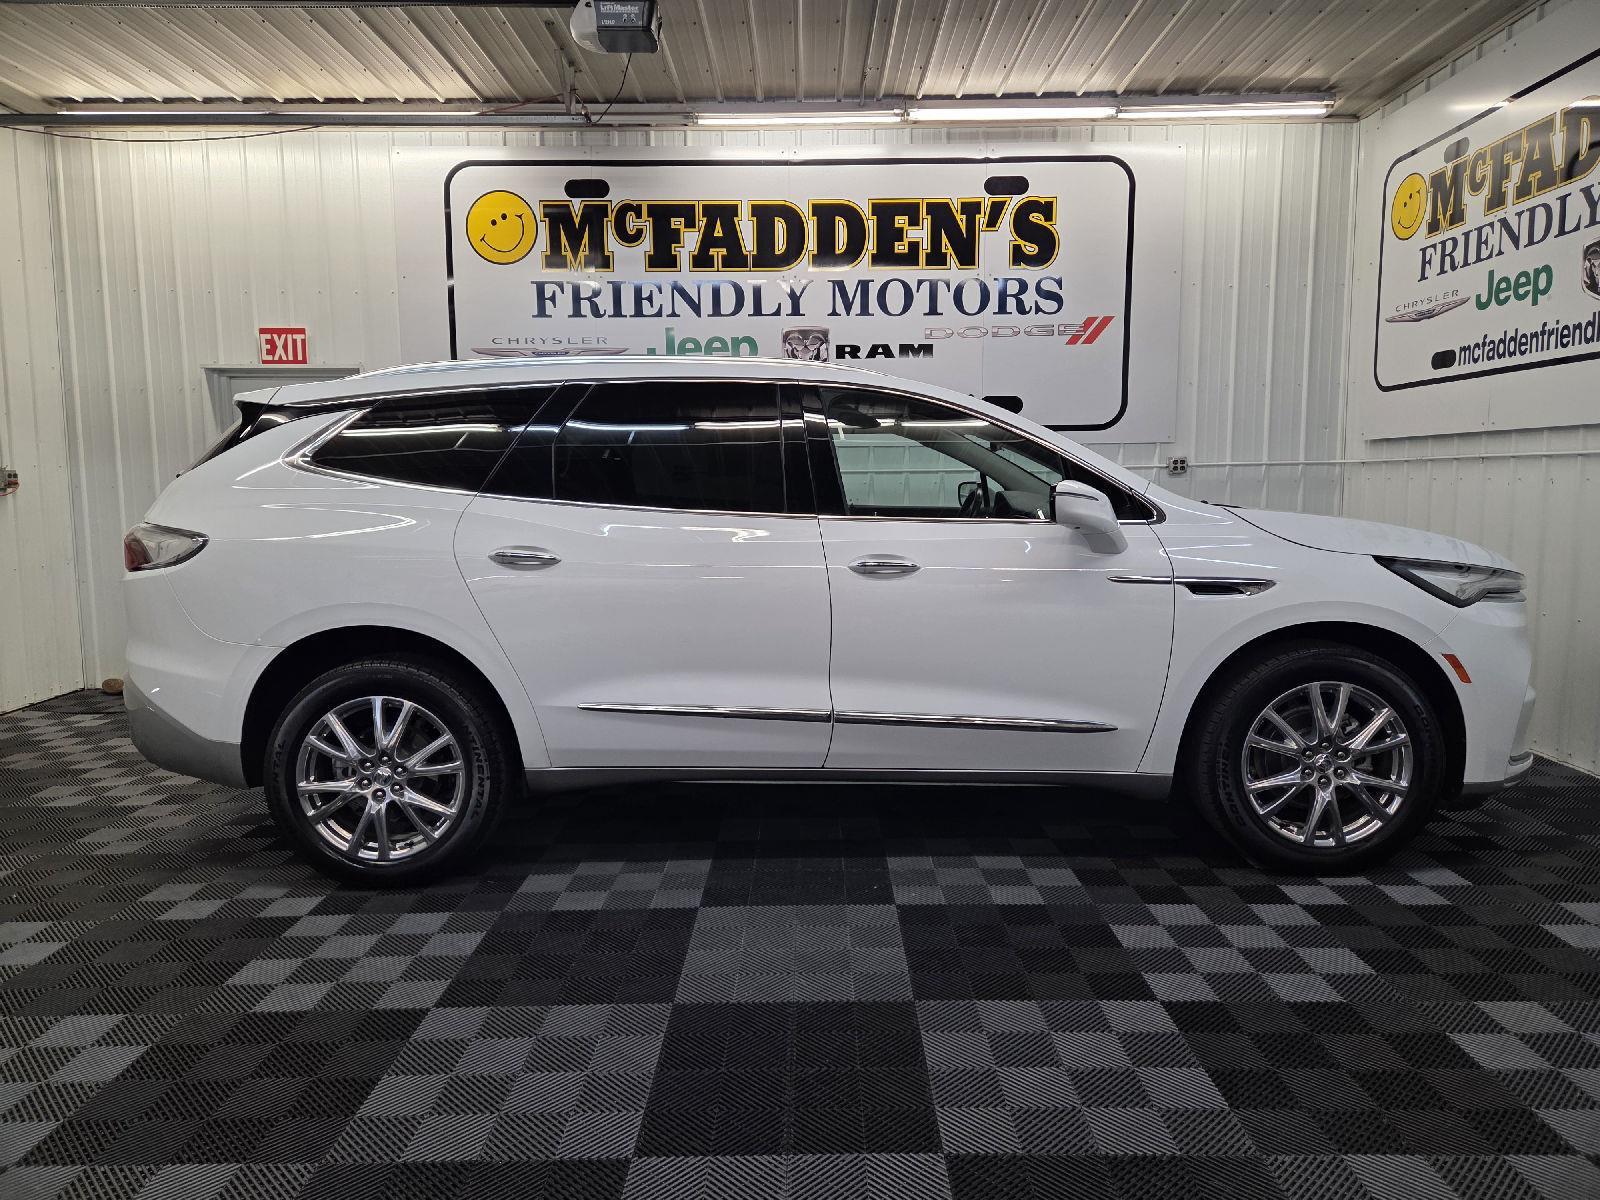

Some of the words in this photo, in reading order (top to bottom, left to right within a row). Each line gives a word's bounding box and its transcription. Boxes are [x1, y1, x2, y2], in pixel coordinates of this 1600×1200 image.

[539, 196, 1060, 272] McFADDEN'S
[1417, 182, 1600, 283] FRIENDLY
[530, 279, 813, 319] FRIENDLY
[827, 276, 1065, 317] MOTORS
[1395, 289, 1459, 313] CHRYSLER
[1475, 263, 1553, 311] Jeep
[491, 336, 608, 345] CHRYSLER
[924, 323, 1085, 340] DODGE
[259, 333, 306, 361] EXIT
[835, 343, 934, 359] RAM
